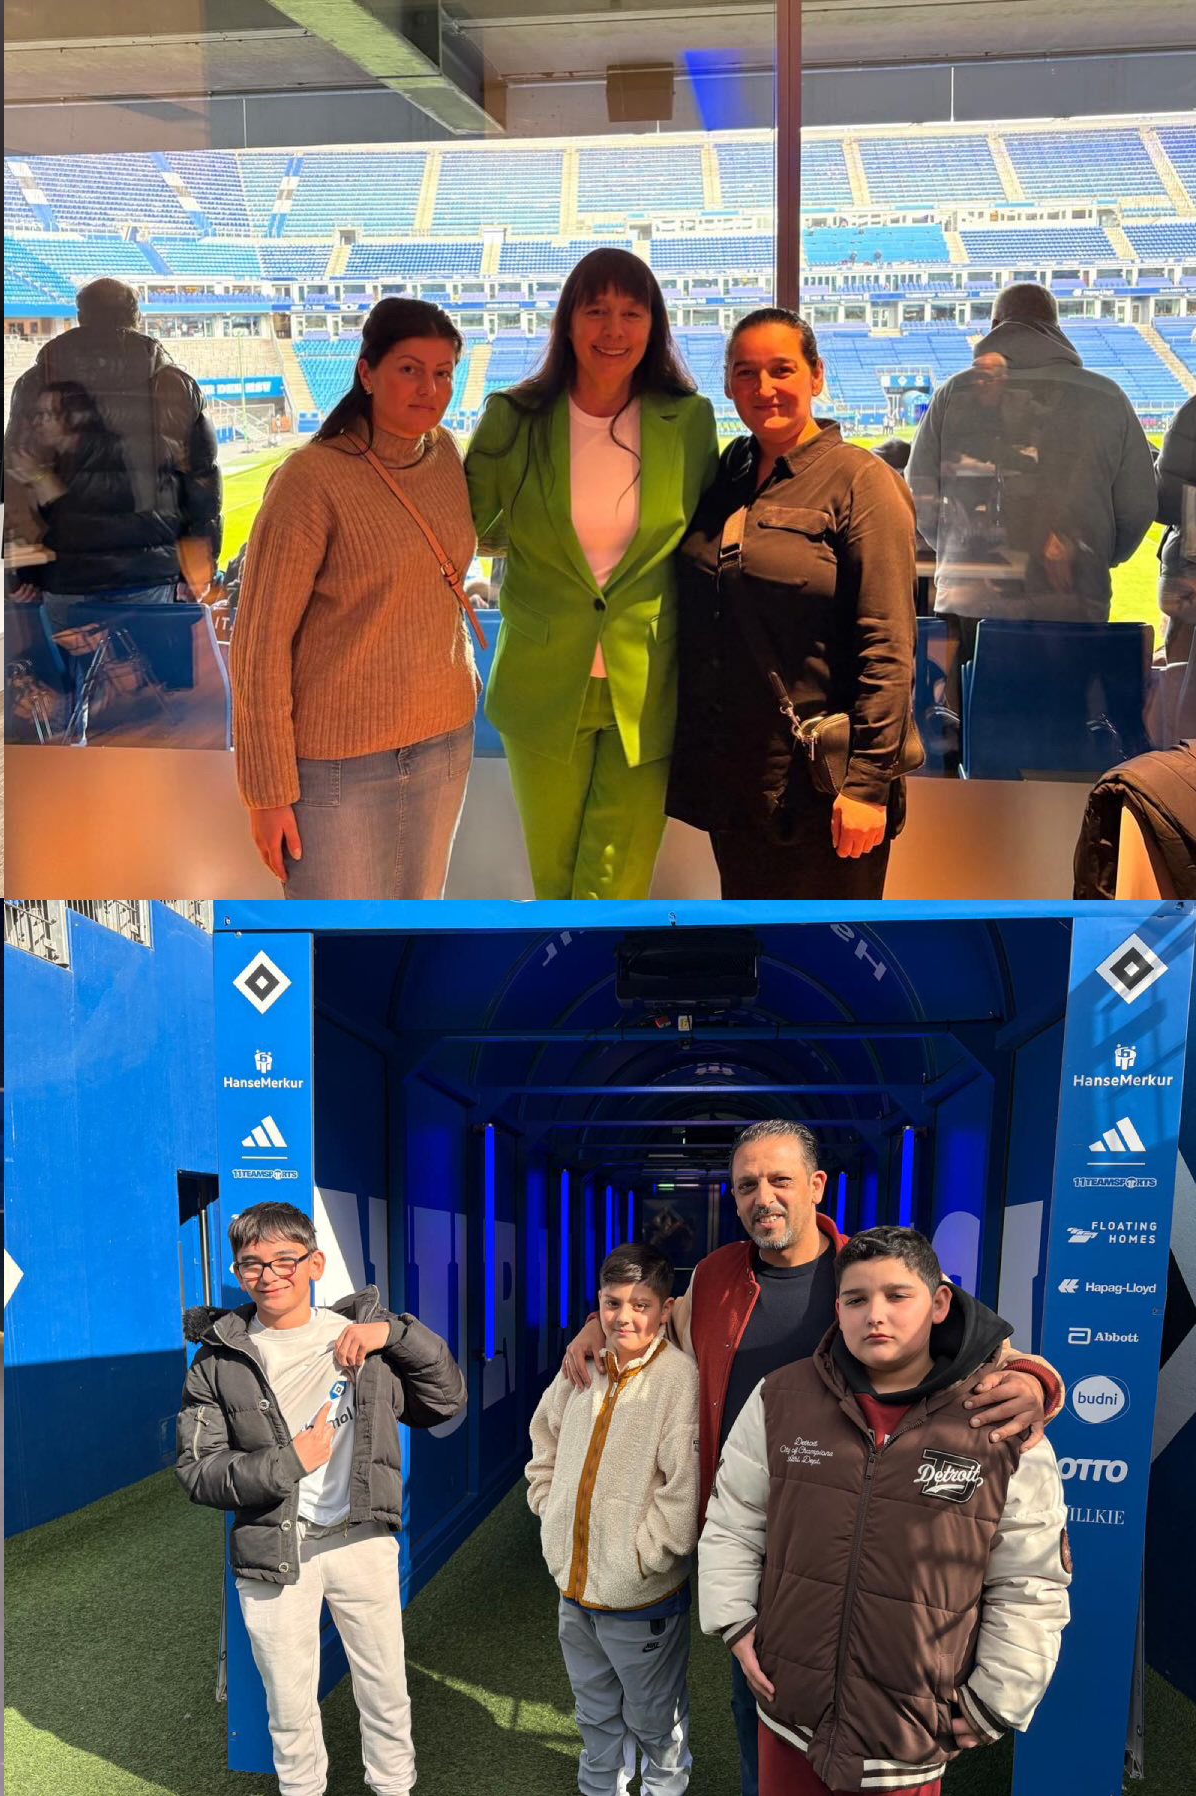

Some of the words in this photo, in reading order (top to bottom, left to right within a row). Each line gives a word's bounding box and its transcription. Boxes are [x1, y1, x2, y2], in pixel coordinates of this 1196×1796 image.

[224, 1076, 304, 1088] HanseMerkur
[1073, 1074, 1173, 1087] HanseMerkur
[1091, 1221, 1157, 1231] FLOATING
[1109, 1235, 1156, 1244] HOMES
[1085, 1282, 1156, 1295] Hapag-Lloyd
[1094, 1332, 1139, 1343] Abbott
[1077, 1391, 1118, 1405] budni
[1057, 1457, 1128, 1483] OTTO
[914, 1464, 984, 1494] Detroit
[1067, 1505, 1124, 1524] ILLKIE
